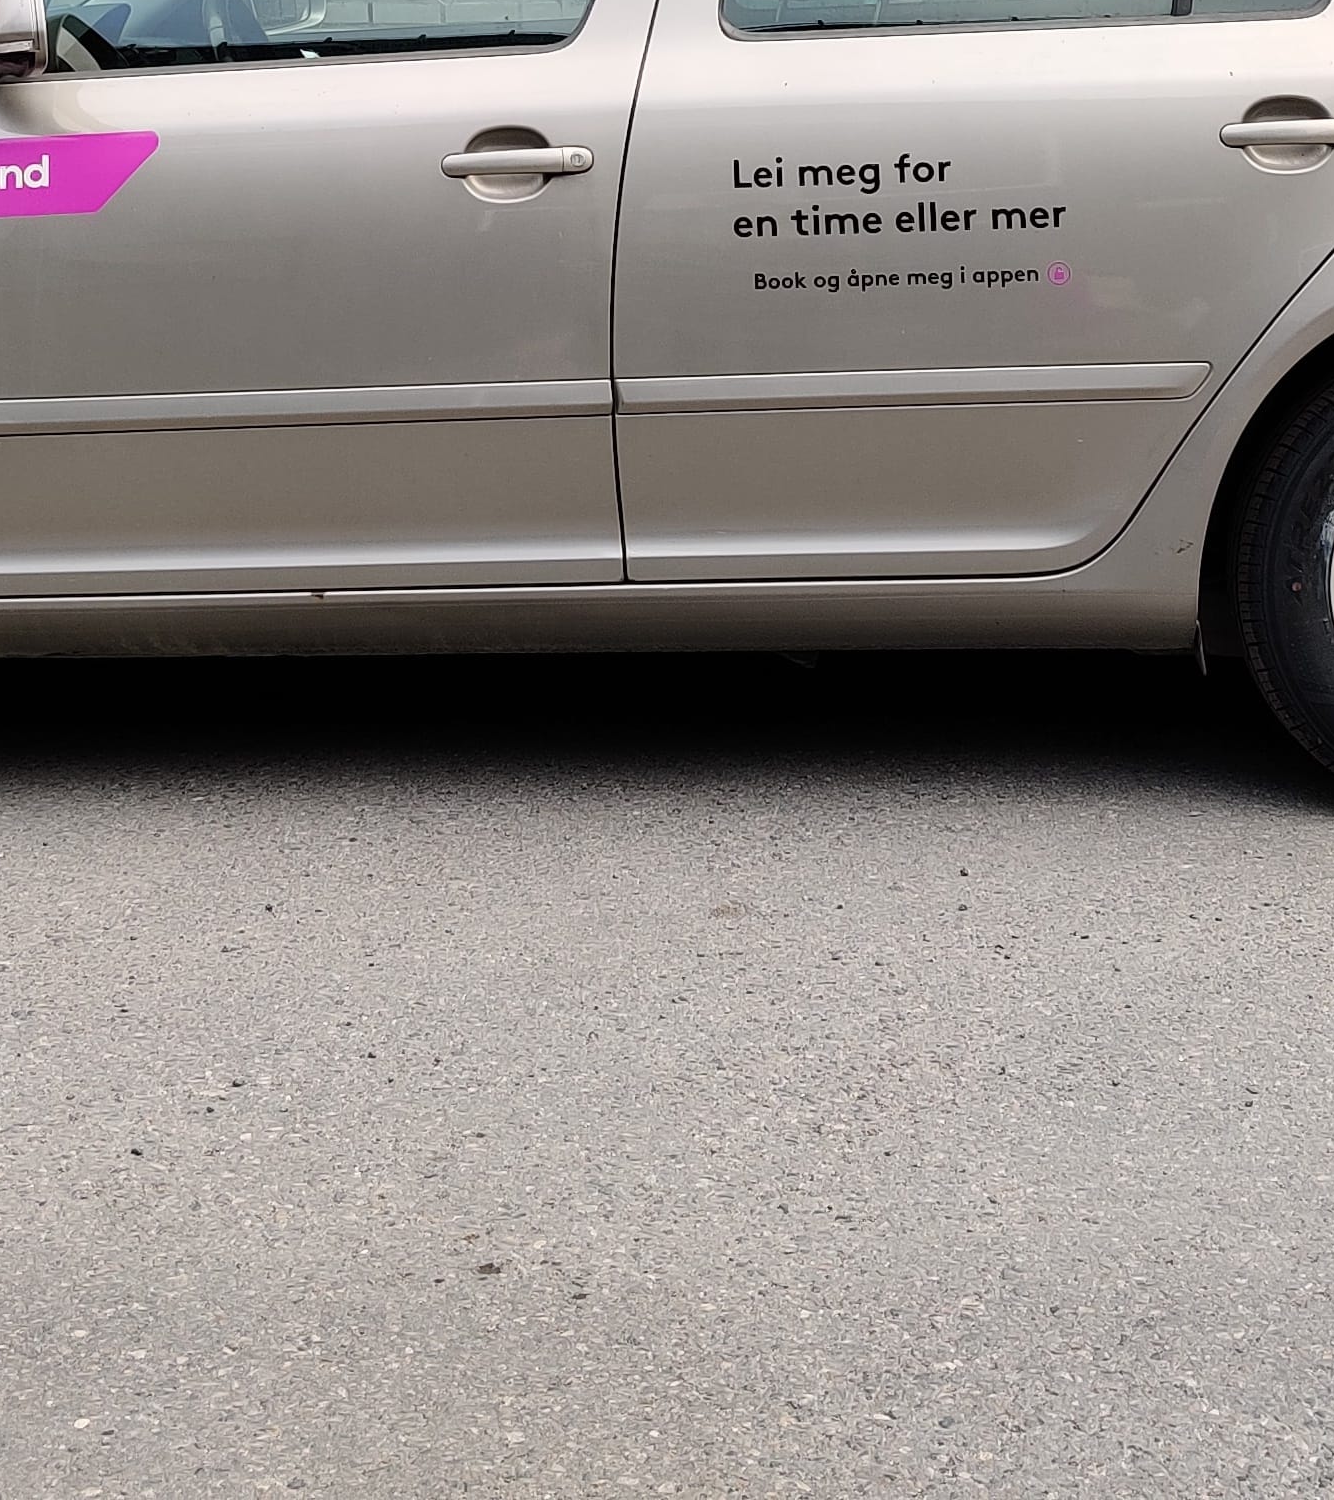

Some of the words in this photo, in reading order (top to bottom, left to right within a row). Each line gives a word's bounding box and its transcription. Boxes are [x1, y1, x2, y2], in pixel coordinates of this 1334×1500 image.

[733, 157, 783, 188] Lei
[798, 163, 880, 194] meg
[894, 153, 951, 183] for
[733, 214, 778, 238] en
[791, 205, 883, 235] time
[895, 202, 977, 232] eller
[991, 206, 1066, 230] mer
[754, 272, 807, 290] Book
[814, 275, 840, 292] og
[847, 269, 900, 291] åpne
[907, 272, 953, 288] meg
[960, 266, 966, 284] i
[972, 269, 1039, 287] appen
